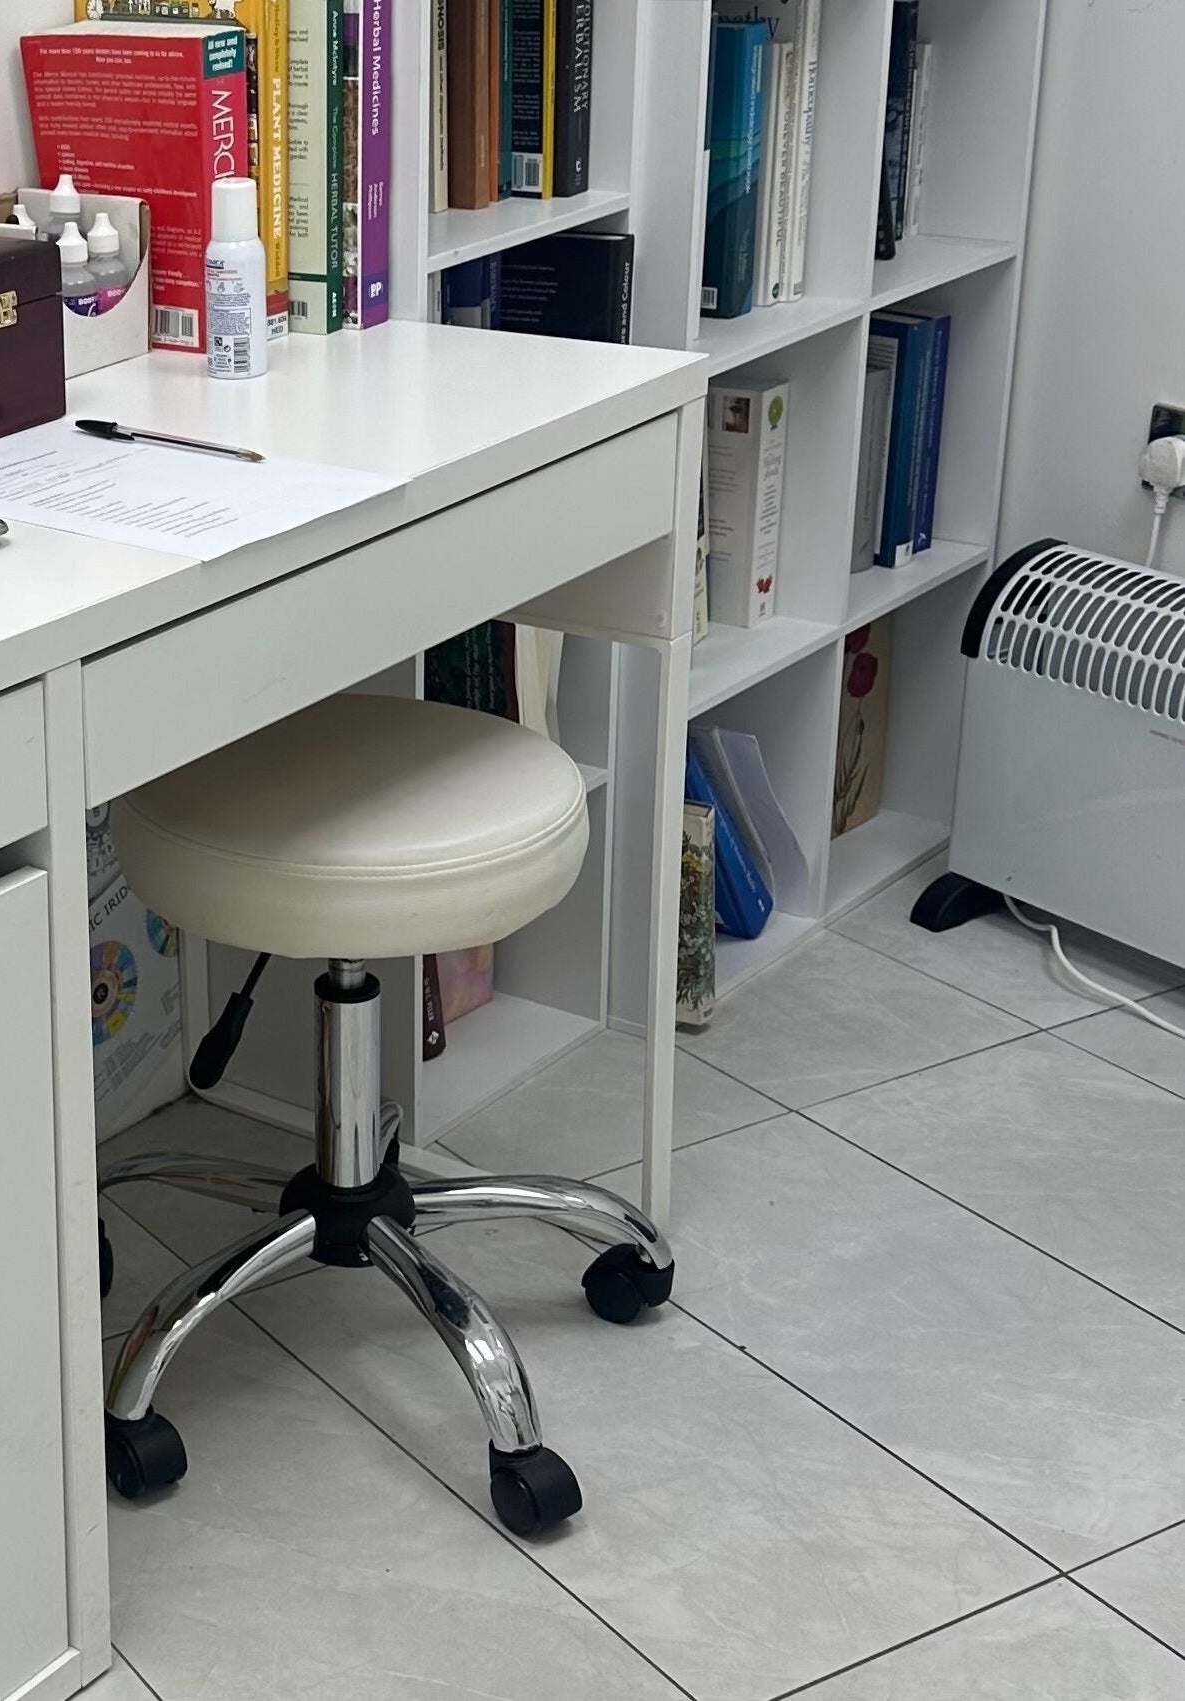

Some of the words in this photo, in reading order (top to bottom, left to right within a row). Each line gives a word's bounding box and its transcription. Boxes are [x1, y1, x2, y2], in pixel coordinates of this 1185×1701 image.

[372, 0, 383, 52] Herbal
[272, 77, 282, 140] PLANT
[371, 55, 382, 136] Medicines
[272, 145, 282, 239] MEDICINE
[330, 173, 338, 222] HERBAL
[330, 226, 338, 269] TUTOR
